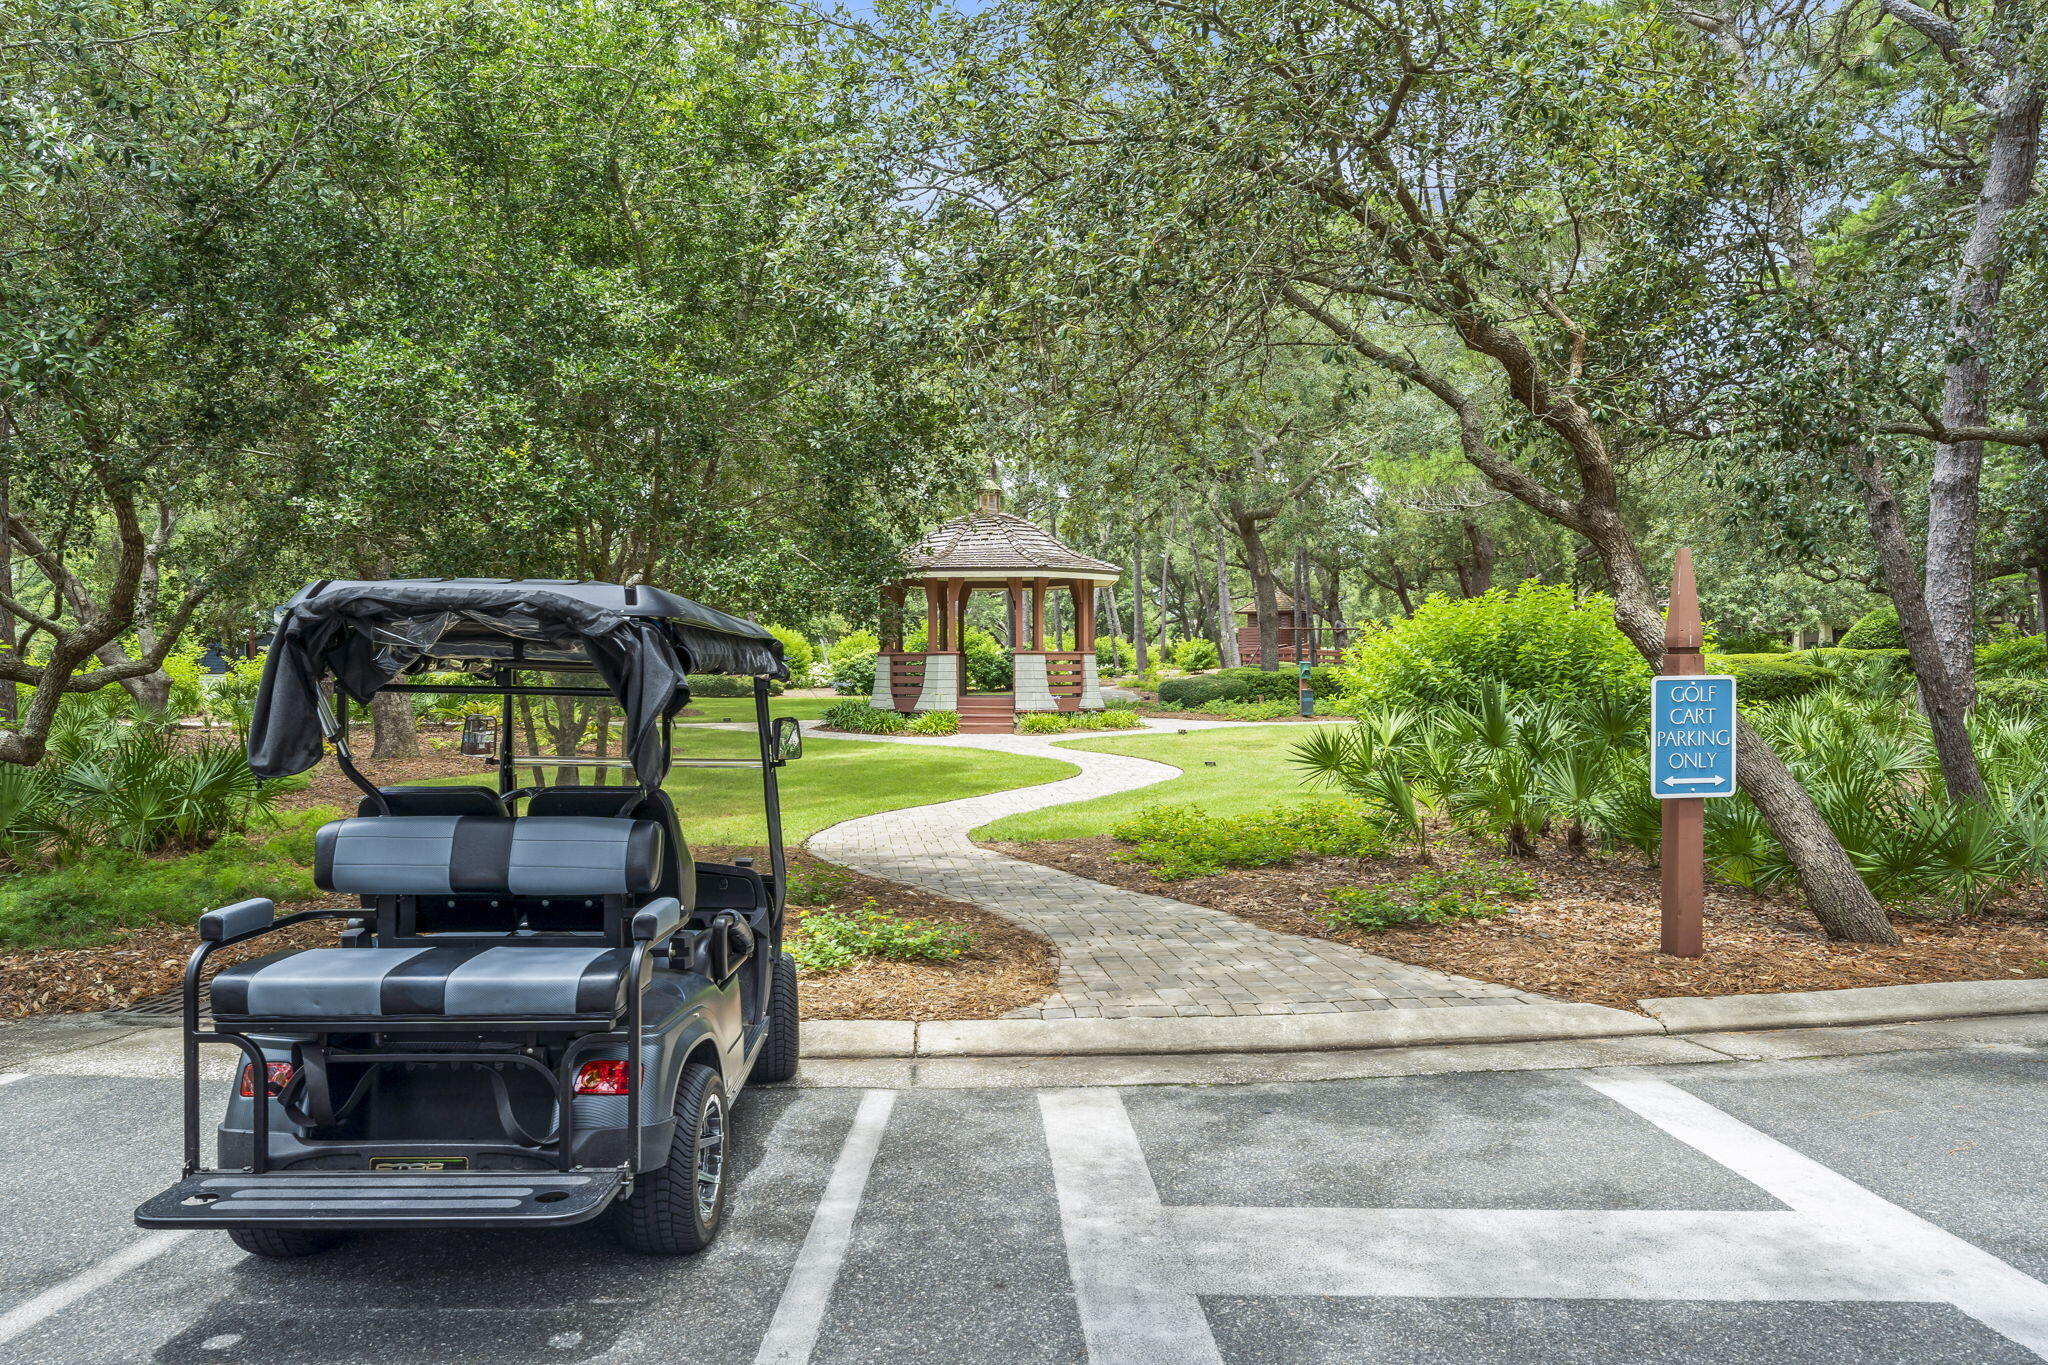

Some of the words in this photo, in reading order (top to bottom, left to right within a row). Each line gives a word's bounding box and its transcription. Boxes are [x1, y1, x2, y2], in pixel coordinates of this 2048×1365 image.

[1671, 685, 1717, 703] GOLF
[1670, 707, 1717, 725] CART
[1657, 729, 1730, 747] PARKING
[1669, 752, 1718, 769] ONLY
